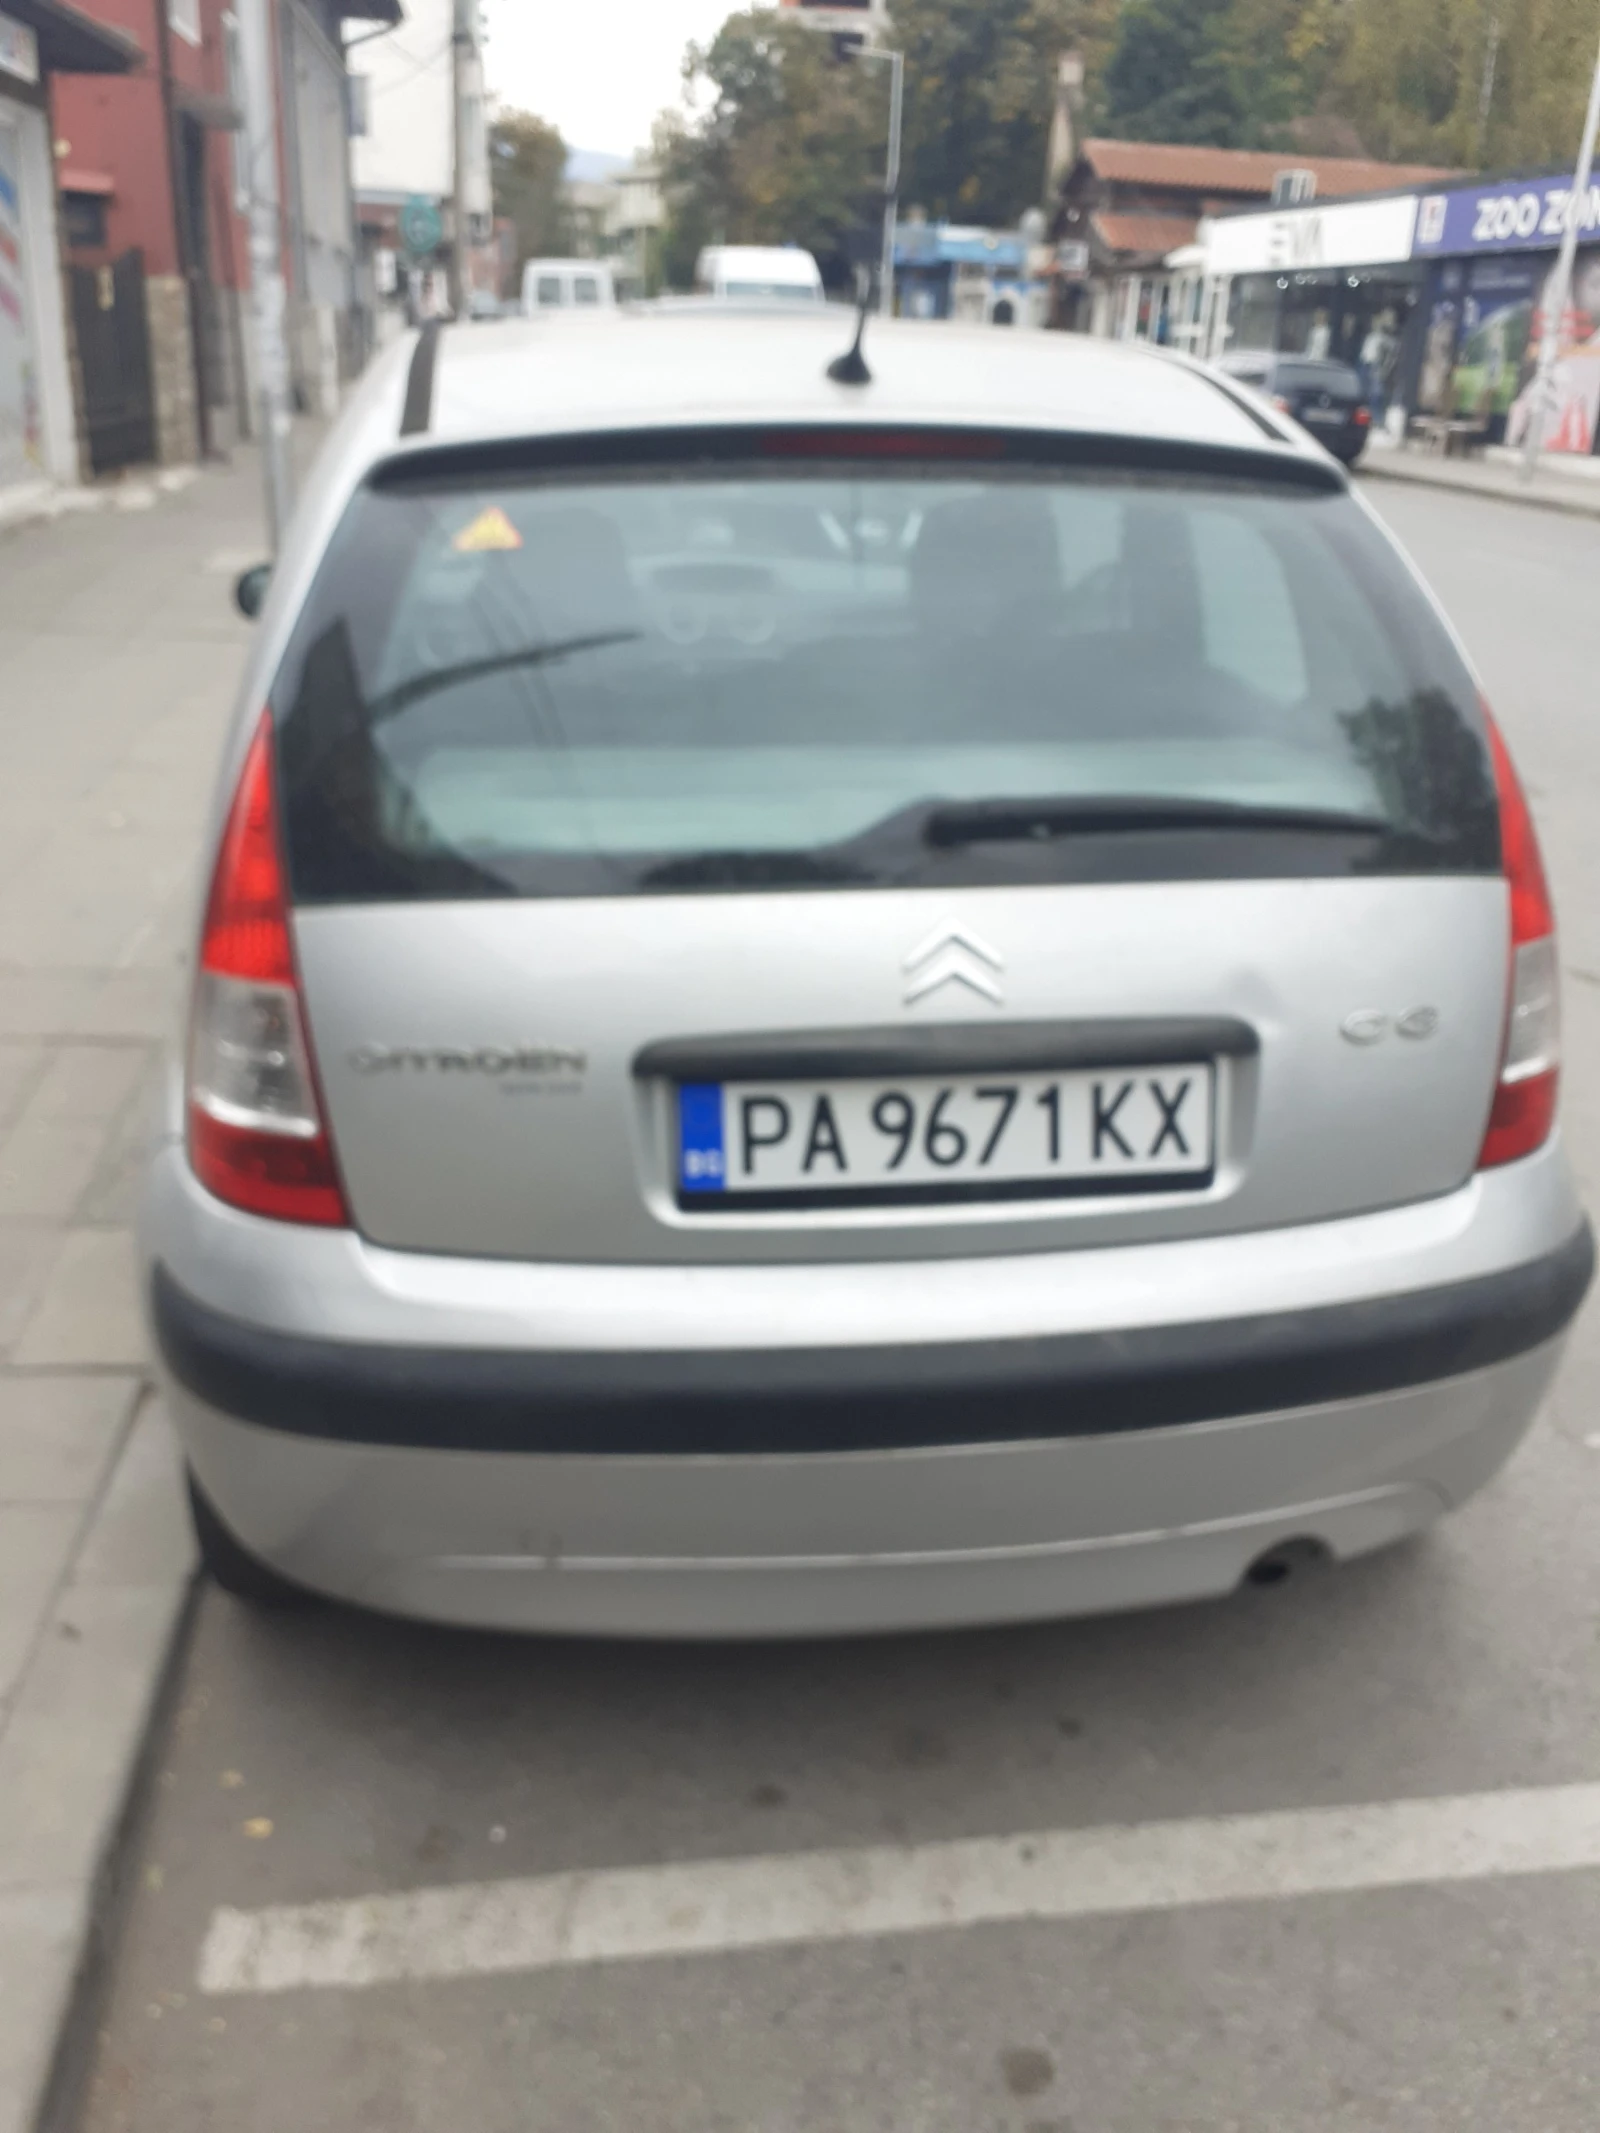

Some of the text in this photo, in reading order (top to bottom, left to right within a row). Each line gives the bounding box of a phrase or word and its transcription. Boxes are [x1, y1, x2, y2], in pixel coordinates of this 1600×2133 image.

[1472, 192, 1540, 241] ZOO
[1338, 1004, 1440, 1047] C3
[740, 1079, 1195, 1176] PA 9671 KX
